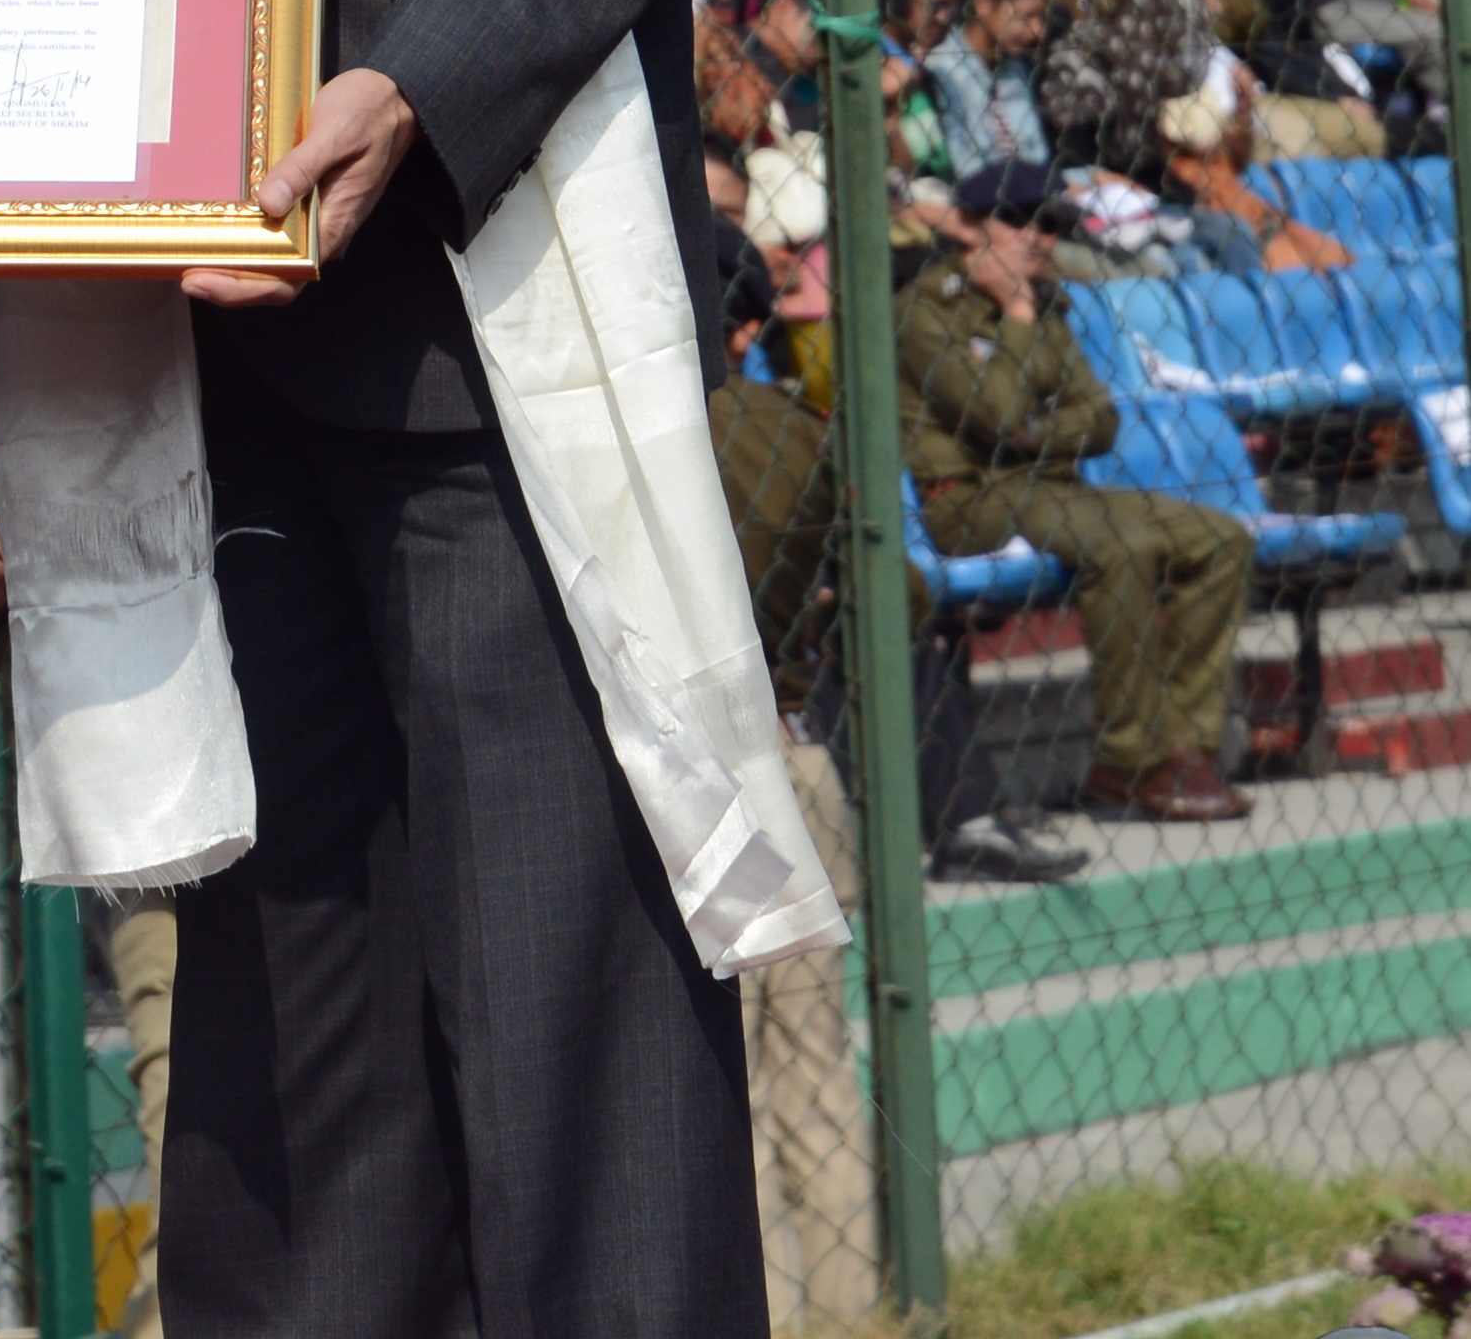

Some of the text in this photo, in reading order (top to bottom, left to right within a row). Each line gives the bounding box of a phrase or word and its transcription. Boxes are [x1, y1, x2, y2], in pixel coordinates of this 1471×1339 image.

[16, 110, 77, 118] SECRETARY
[34, 120, 49, 128] OF
[50, 120, 89, 128] SIKKIM
